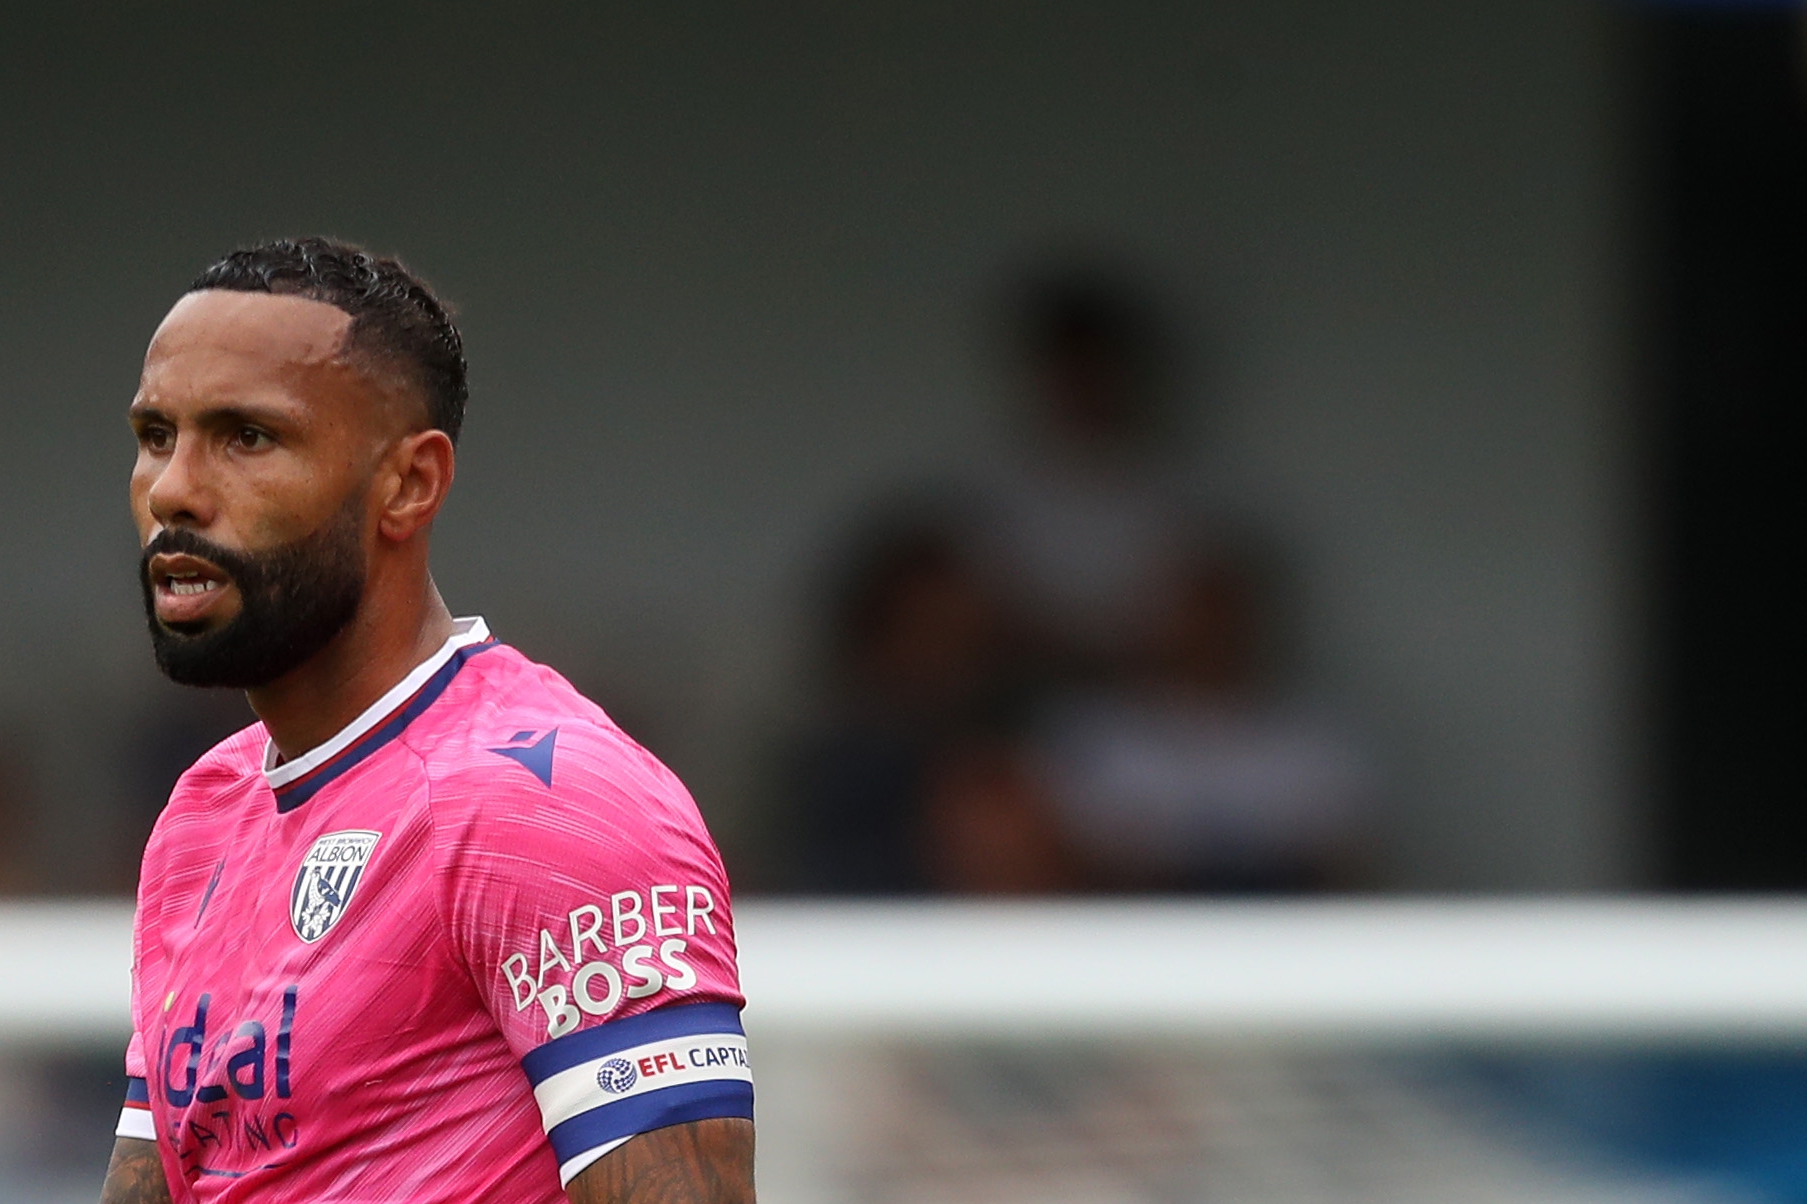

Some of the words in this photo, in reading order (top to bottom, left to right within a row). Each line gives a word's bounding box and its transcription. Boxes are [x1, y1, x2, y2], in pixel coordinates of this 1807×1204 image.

[307, 845, 368, 863] ALBION
[501, 885, 716, 1012] BARBER
[538, 938, 697, 1040] BOSS
[637, 1052, 686, 1078] EFL
